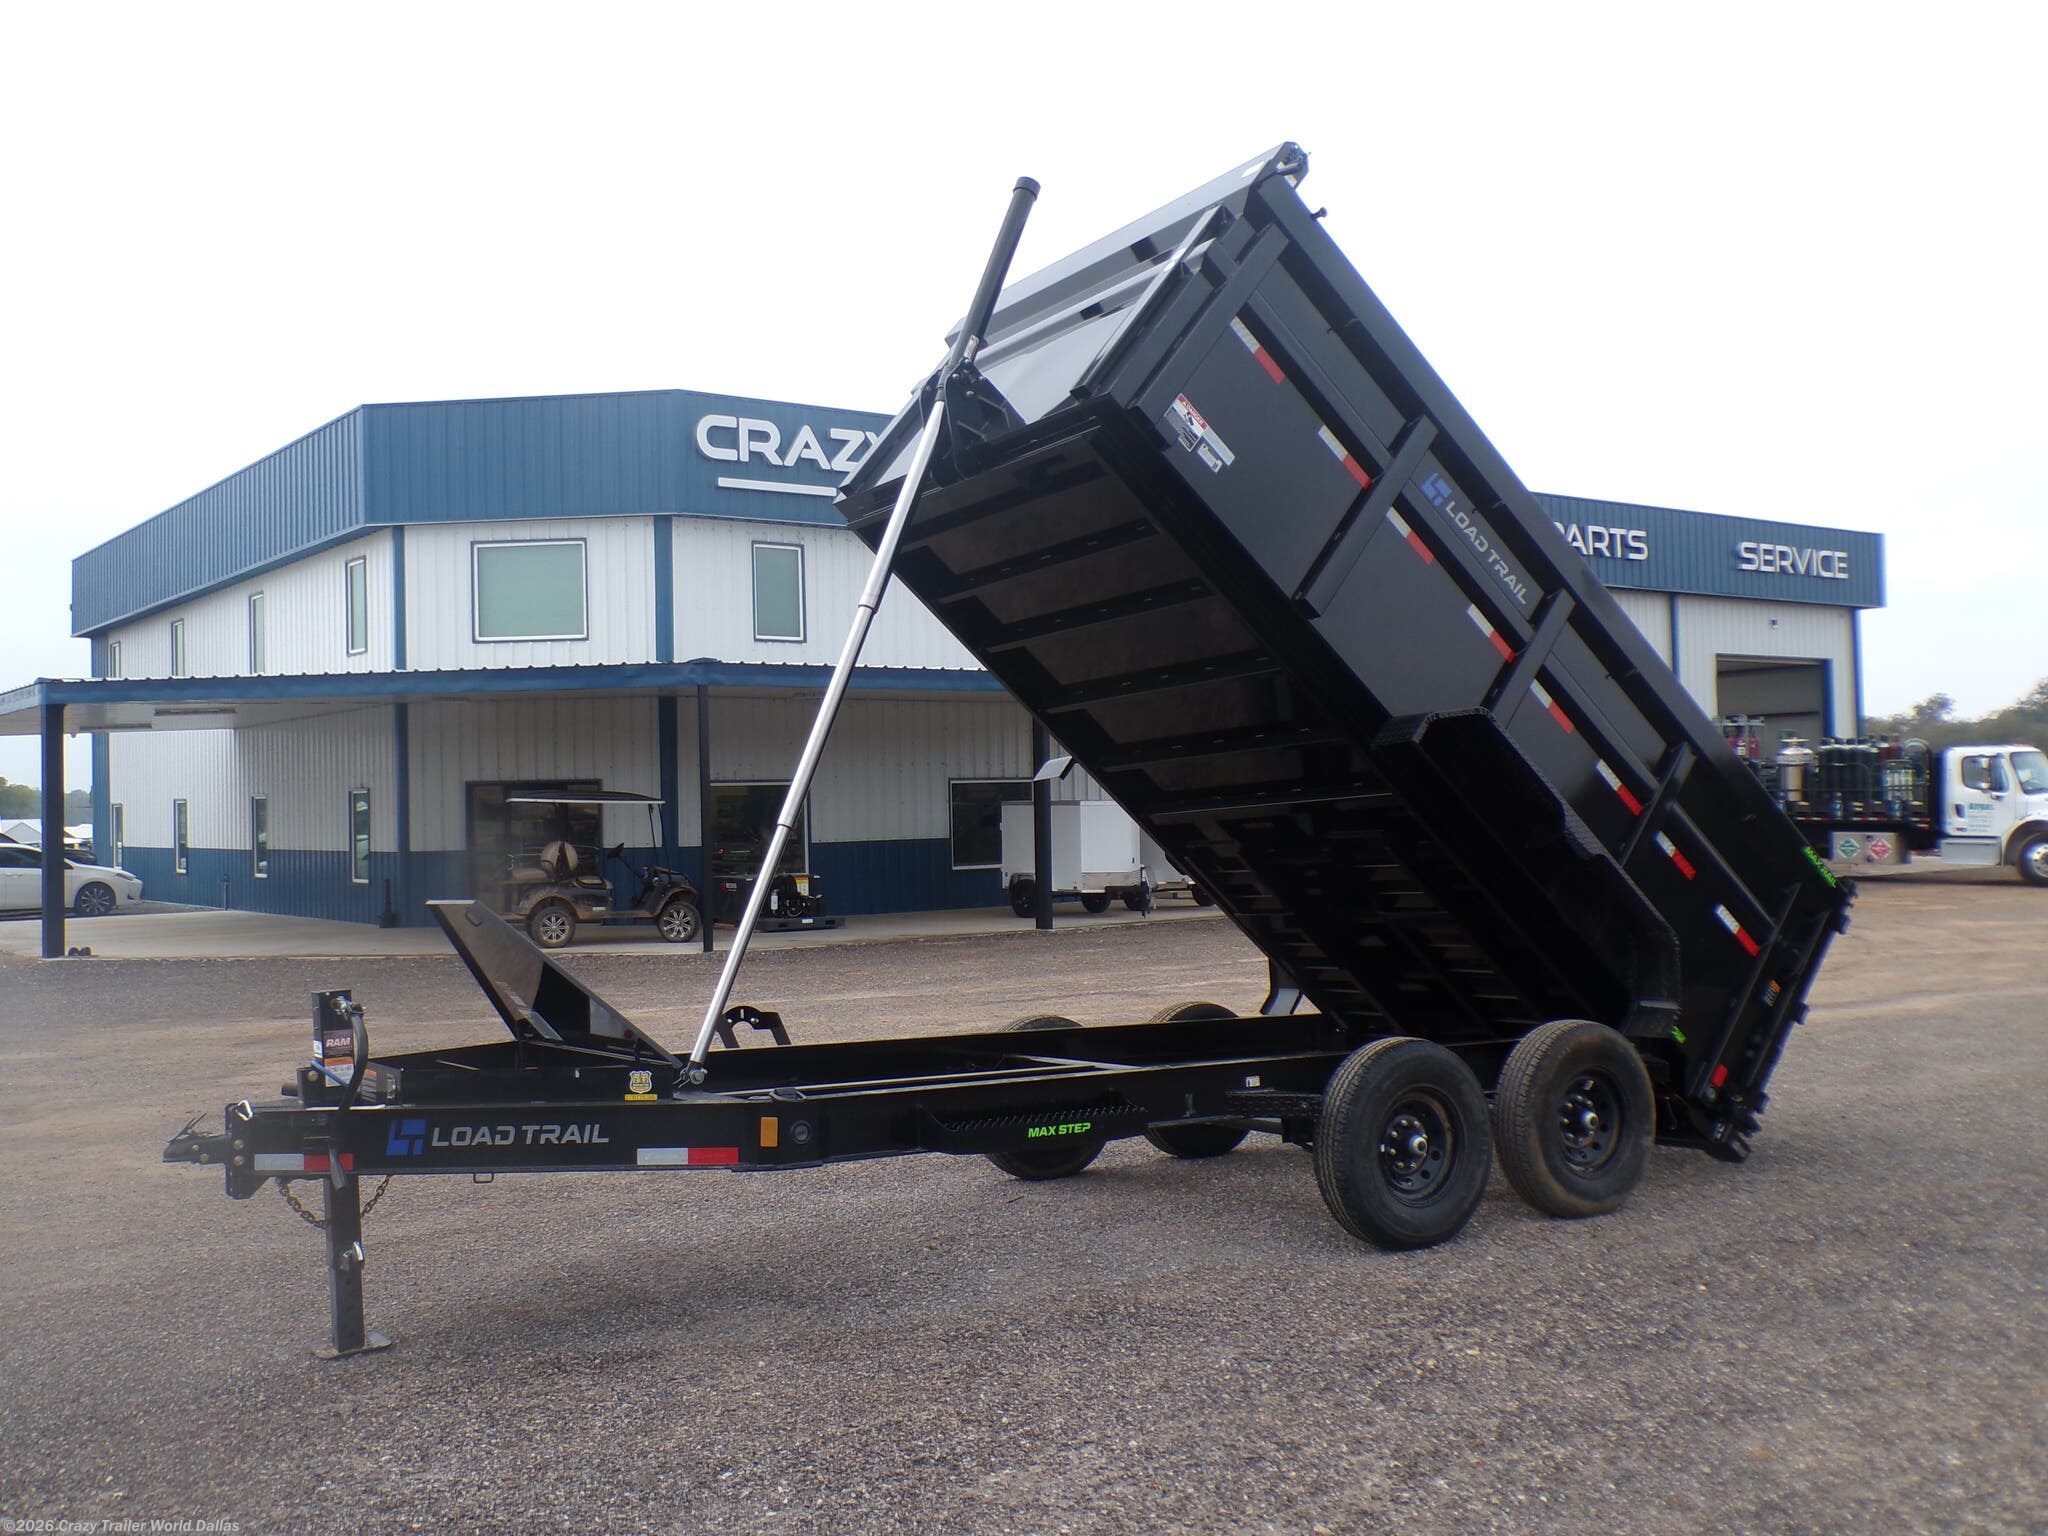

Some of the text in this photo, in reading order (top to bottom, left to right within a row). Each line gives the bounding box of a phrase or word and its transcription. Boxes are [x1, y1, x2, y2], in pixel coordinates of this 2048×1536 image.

[1553, 521, 1649, 560] ARTS
[1445, 501, 1527, 605] LOAD TRAIL
[1739, 541, 1849, 579] SERVICE
[1804, 846, 1822, 868] MAX
[326, 1037, 351, 1048] RAM
[432, 1123, 610, 1147] LOAD TRAIL
[1028, 1122, 1091, 1138] MAX STEP
